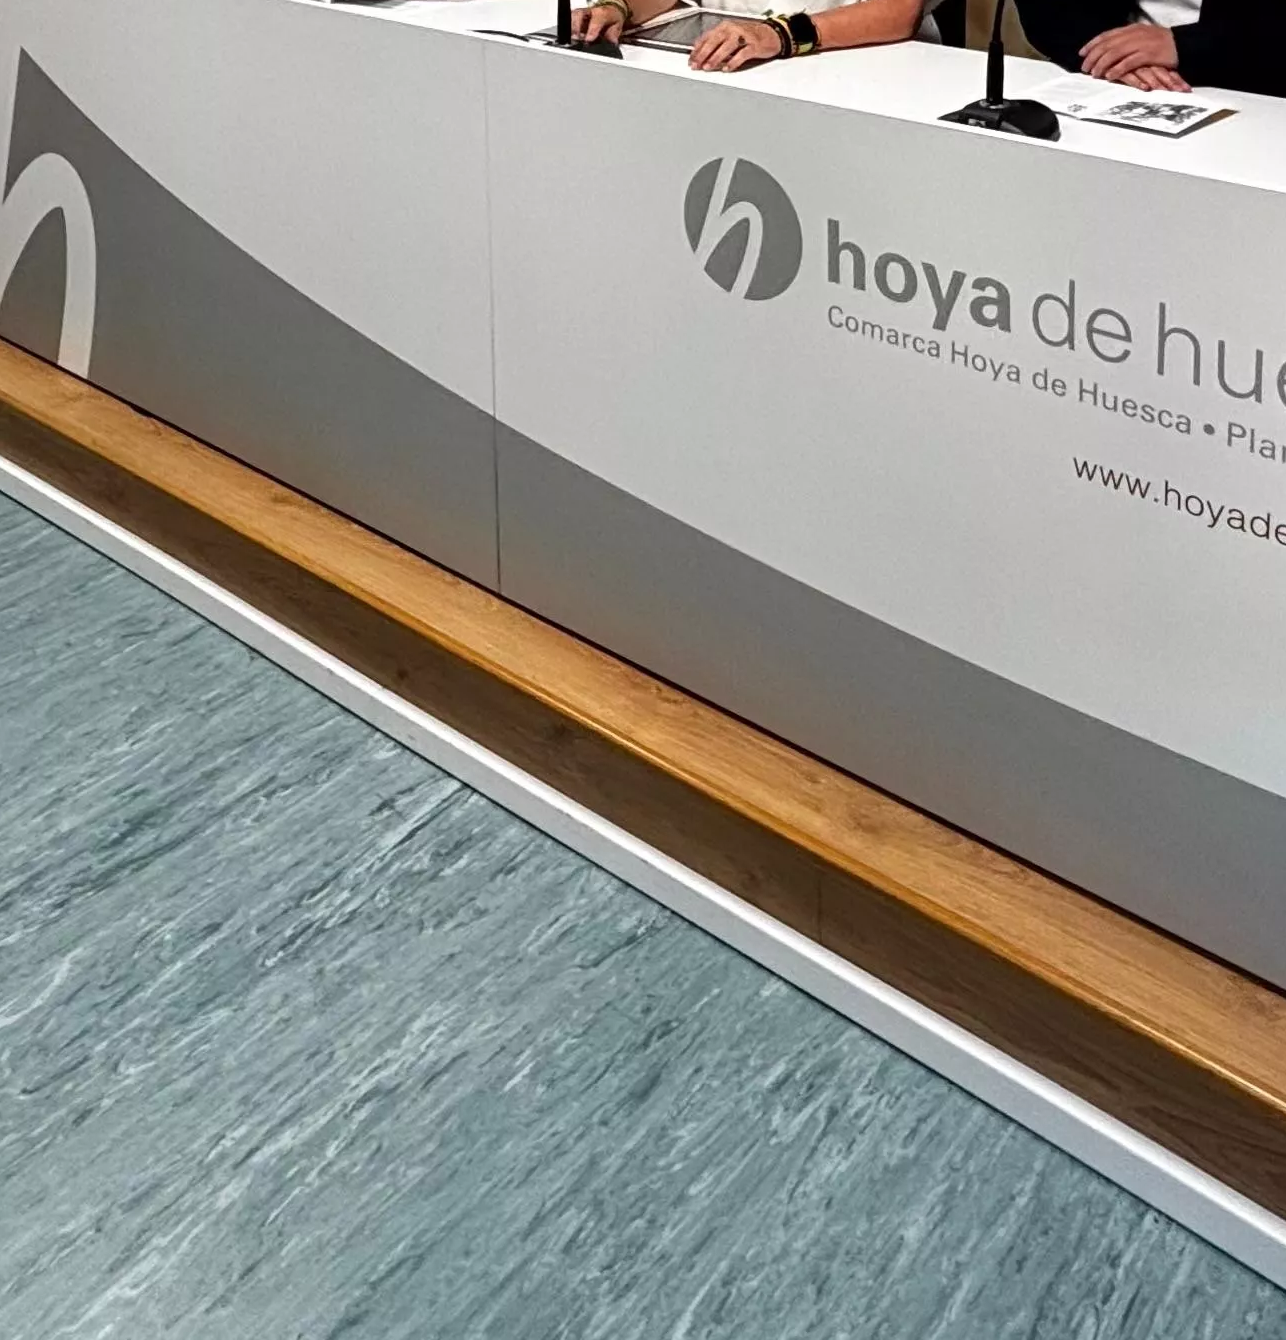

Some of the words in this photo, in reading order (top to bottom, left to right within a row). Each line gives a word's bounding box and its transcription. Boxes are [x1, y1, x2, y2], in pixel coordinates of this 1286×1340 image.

[827, 219, 1012, 333] hoya
[1031, 279, 1133, 364] de
[828, 305, 940, 359] Comarca
[951, 341, 1020, 384] Hoya
[1032, 368, 1067, 397] de
[1079, 378, 1191, 435] Huesca
